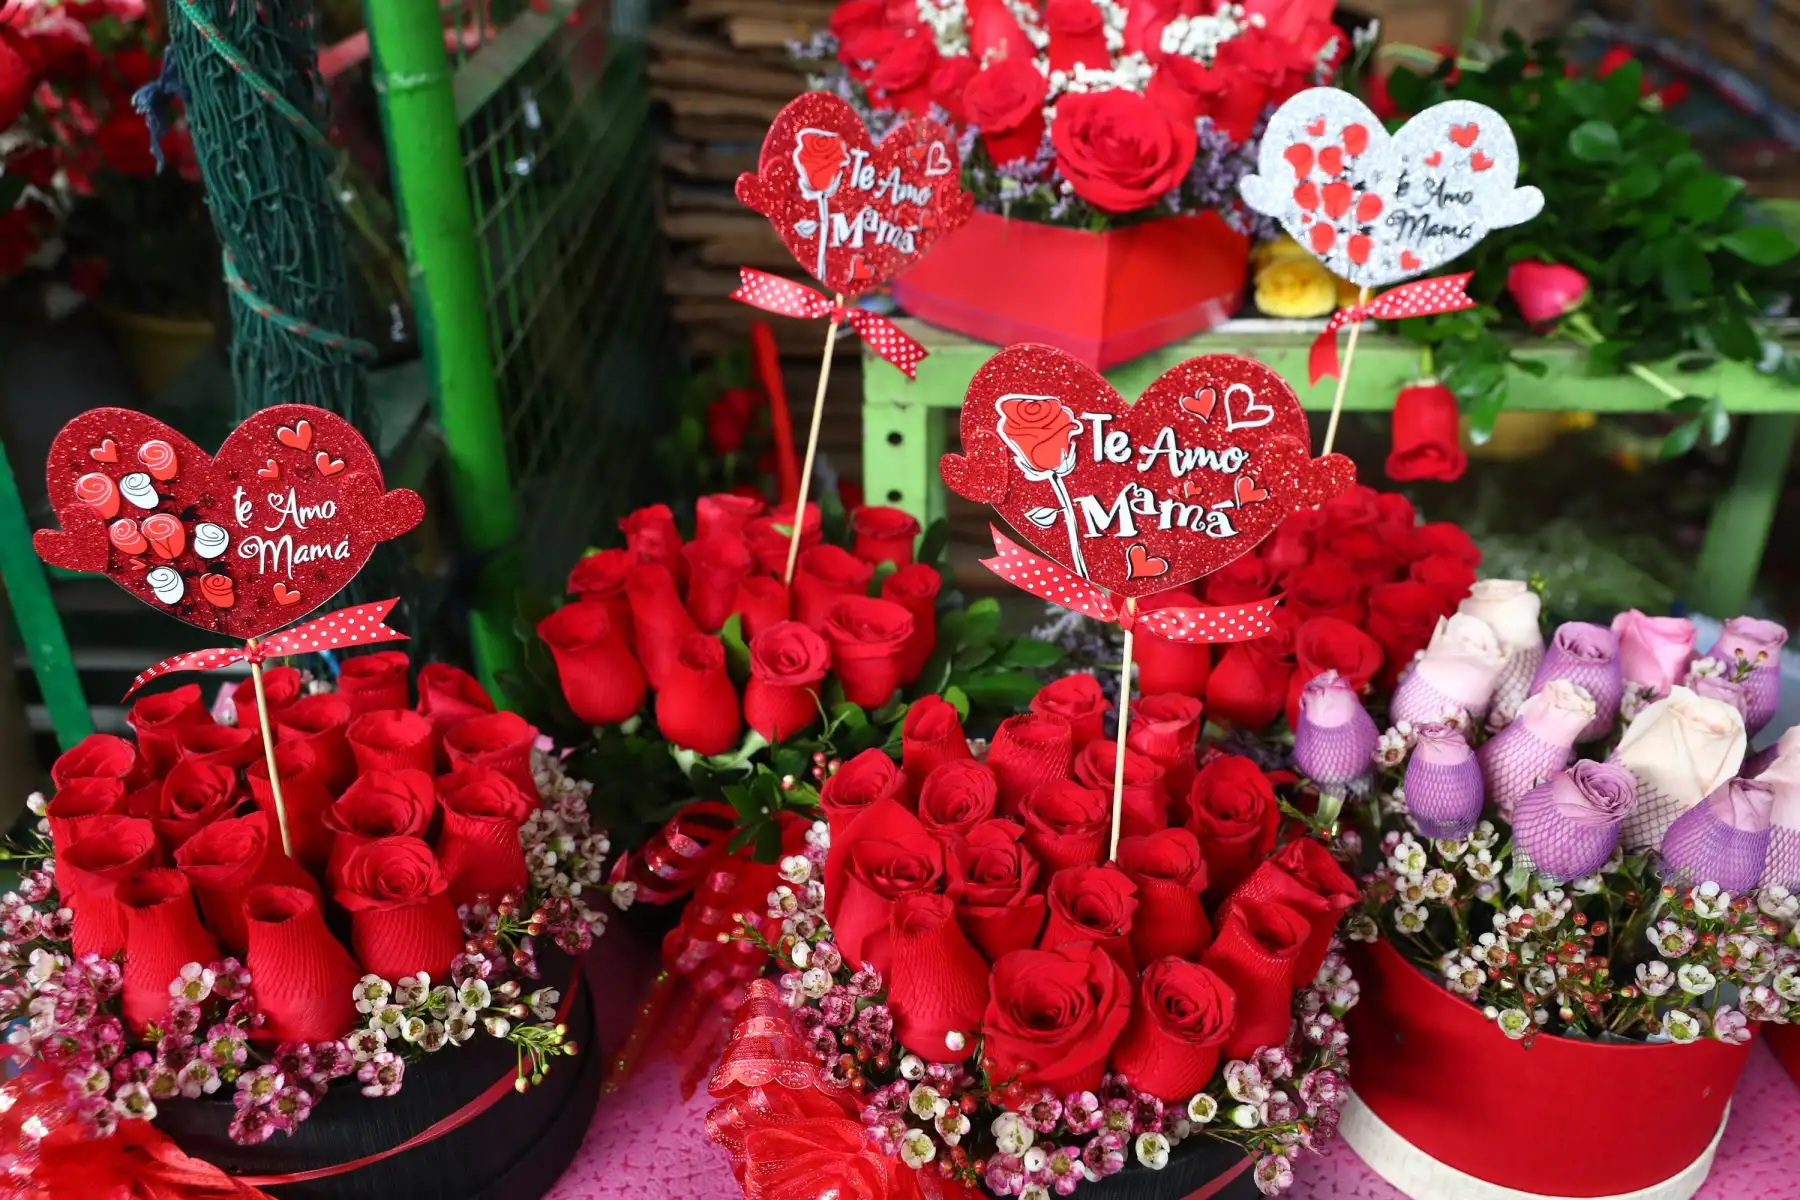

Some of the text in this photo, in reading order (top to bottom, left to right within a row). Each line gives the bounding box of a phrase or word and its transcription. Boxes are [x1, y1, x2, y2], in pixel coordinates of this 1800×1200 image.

[849, 149, 932, 206] Te Amo
[829, 206, 922, 253] Mamá
[1080, 412, 1249, 477] Te Amo
[232, 485, 337, 532] te Amo
[1074, 482, 1239, 539] Mamá
[238, 533, 351, 580] Mamá
